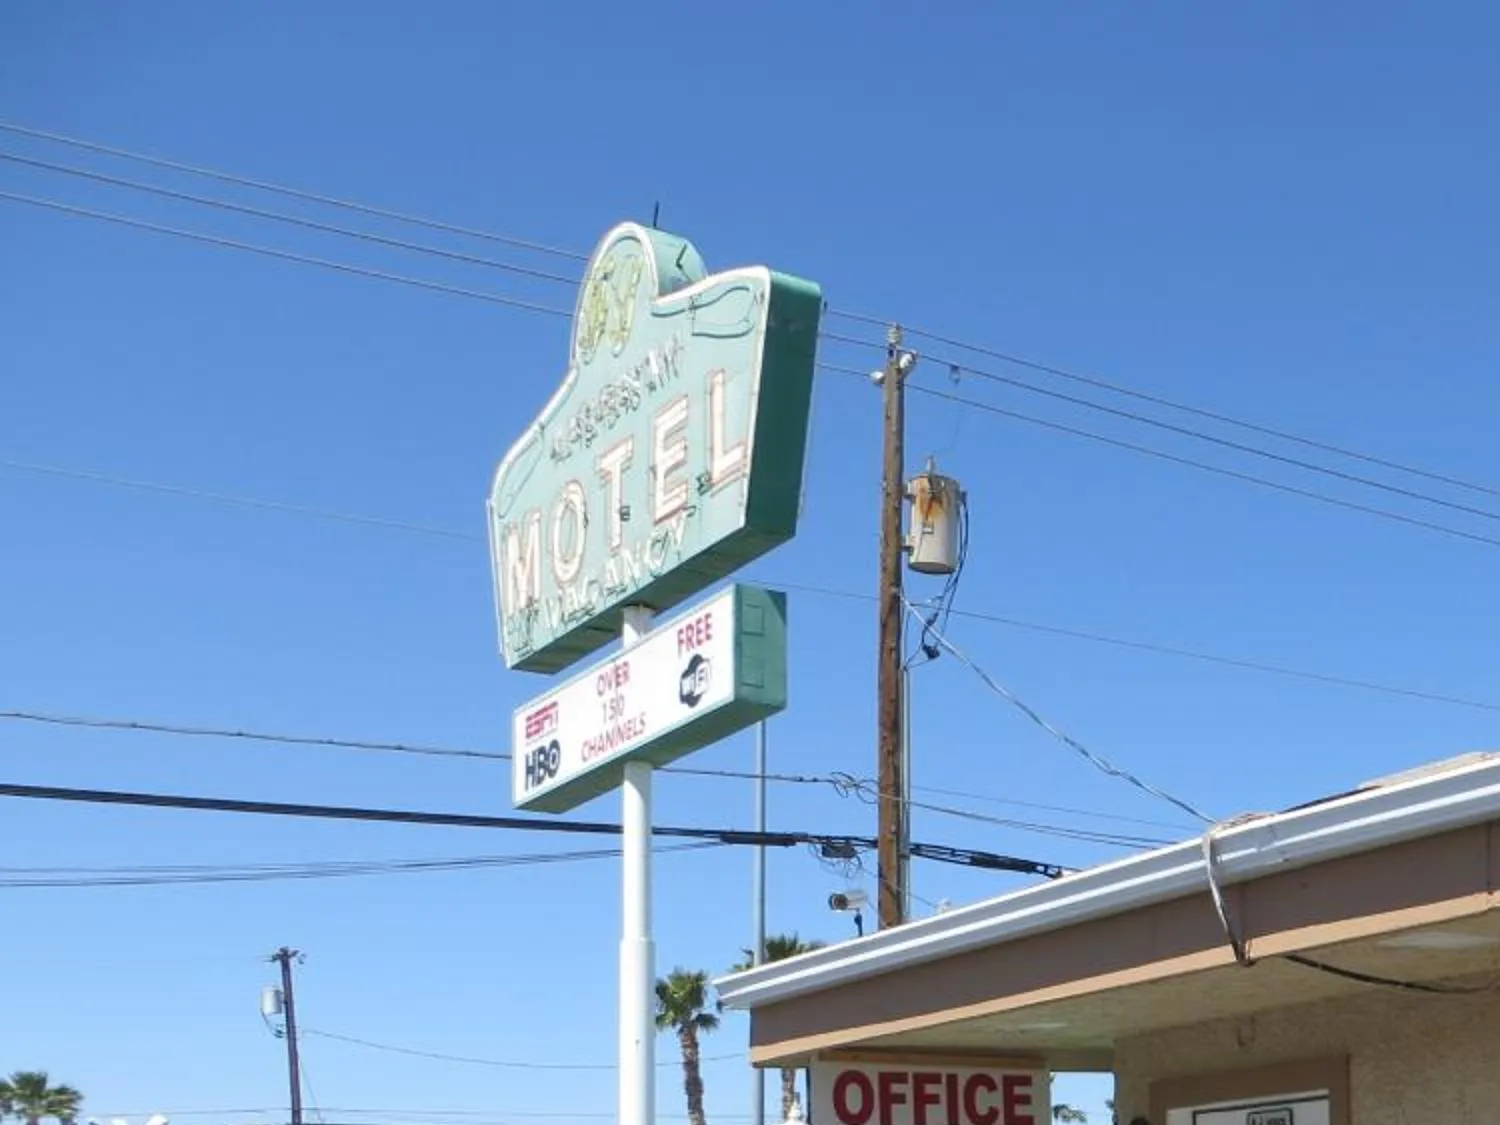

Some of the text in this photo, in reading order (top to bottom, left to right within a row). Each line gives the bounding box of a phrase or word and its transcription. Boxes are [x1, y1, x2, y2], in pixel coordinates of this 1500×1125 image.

[504, 368, 749, 615] MOTEL
[542, 511, 688, 631] VACANCY
[677, 612, 713, 657] FREE
[596, 660, 630, 696] OVER
[525, 701, 559, 740] ESPN
[581, 711, 646, 762] CHANNELS
[525, 739, 561, 791] HBO
